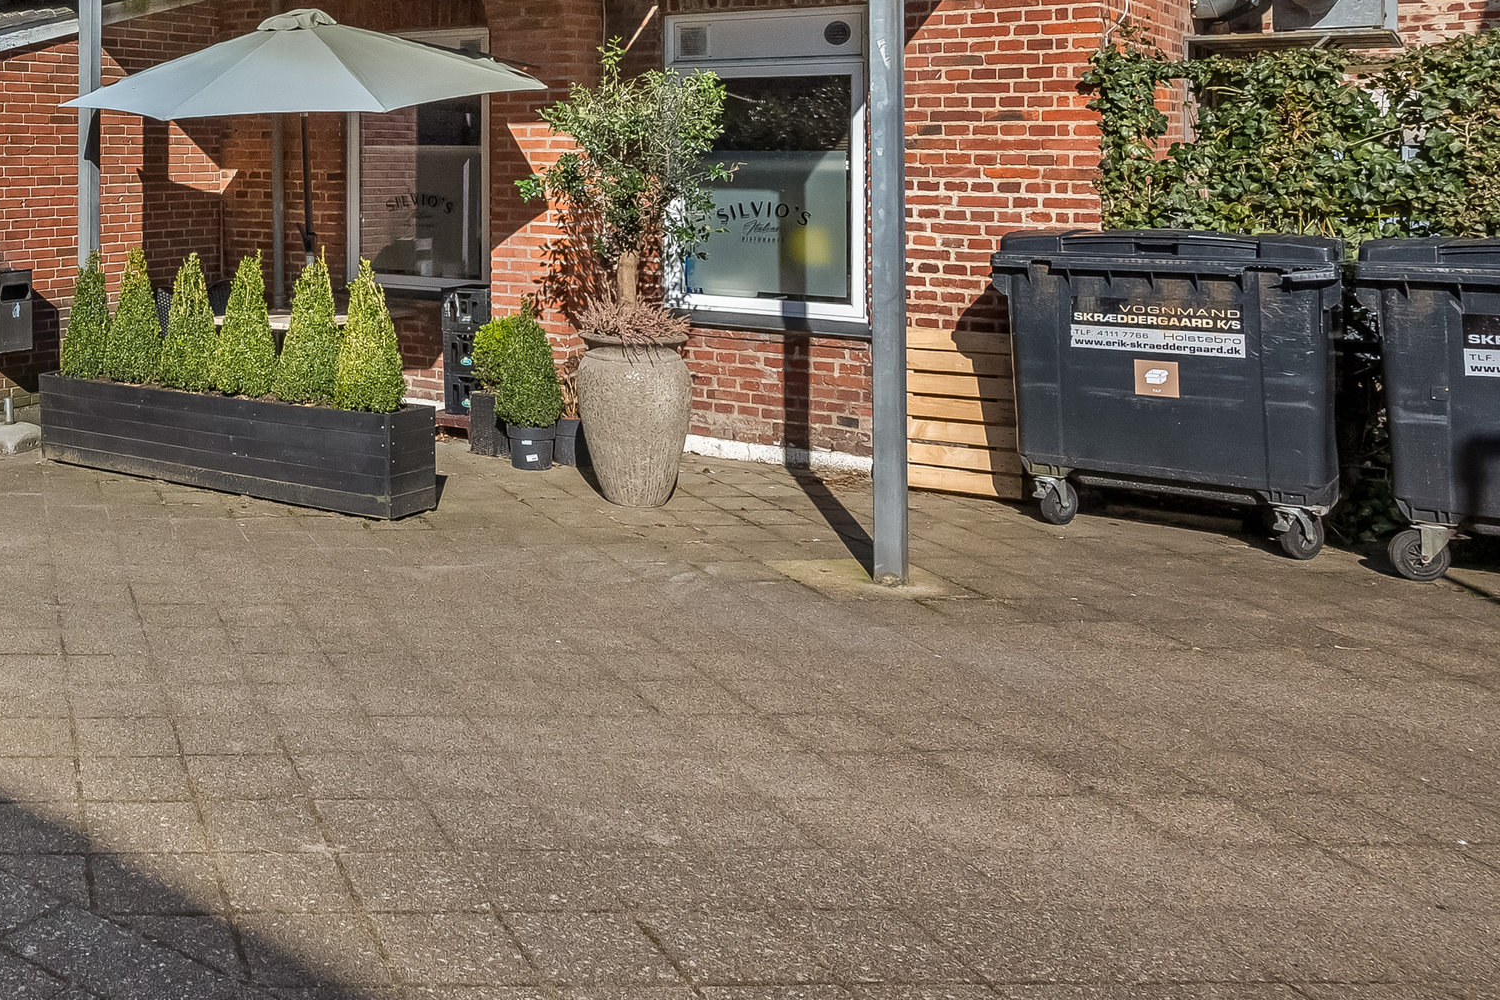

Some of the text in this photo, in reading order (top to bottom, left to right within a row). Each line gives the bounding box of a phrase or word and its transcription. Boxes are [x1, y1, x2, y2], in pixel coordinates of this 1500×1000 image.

[385, 193, 454, 214] SILVIO'S
[716, 201, 812, 226] SILVIO'S
[1119, 304, 1240, 318] VOGNMAND
[1074, 312, 1241, 330] SKRÆDDERGAARD K/S
[1097, 330, 1119, 338] 4111
[1163, 333, 1242, 345] Holstebro
[1074, 338, 1241, 355] www.erik-skraeddergaard.dk
